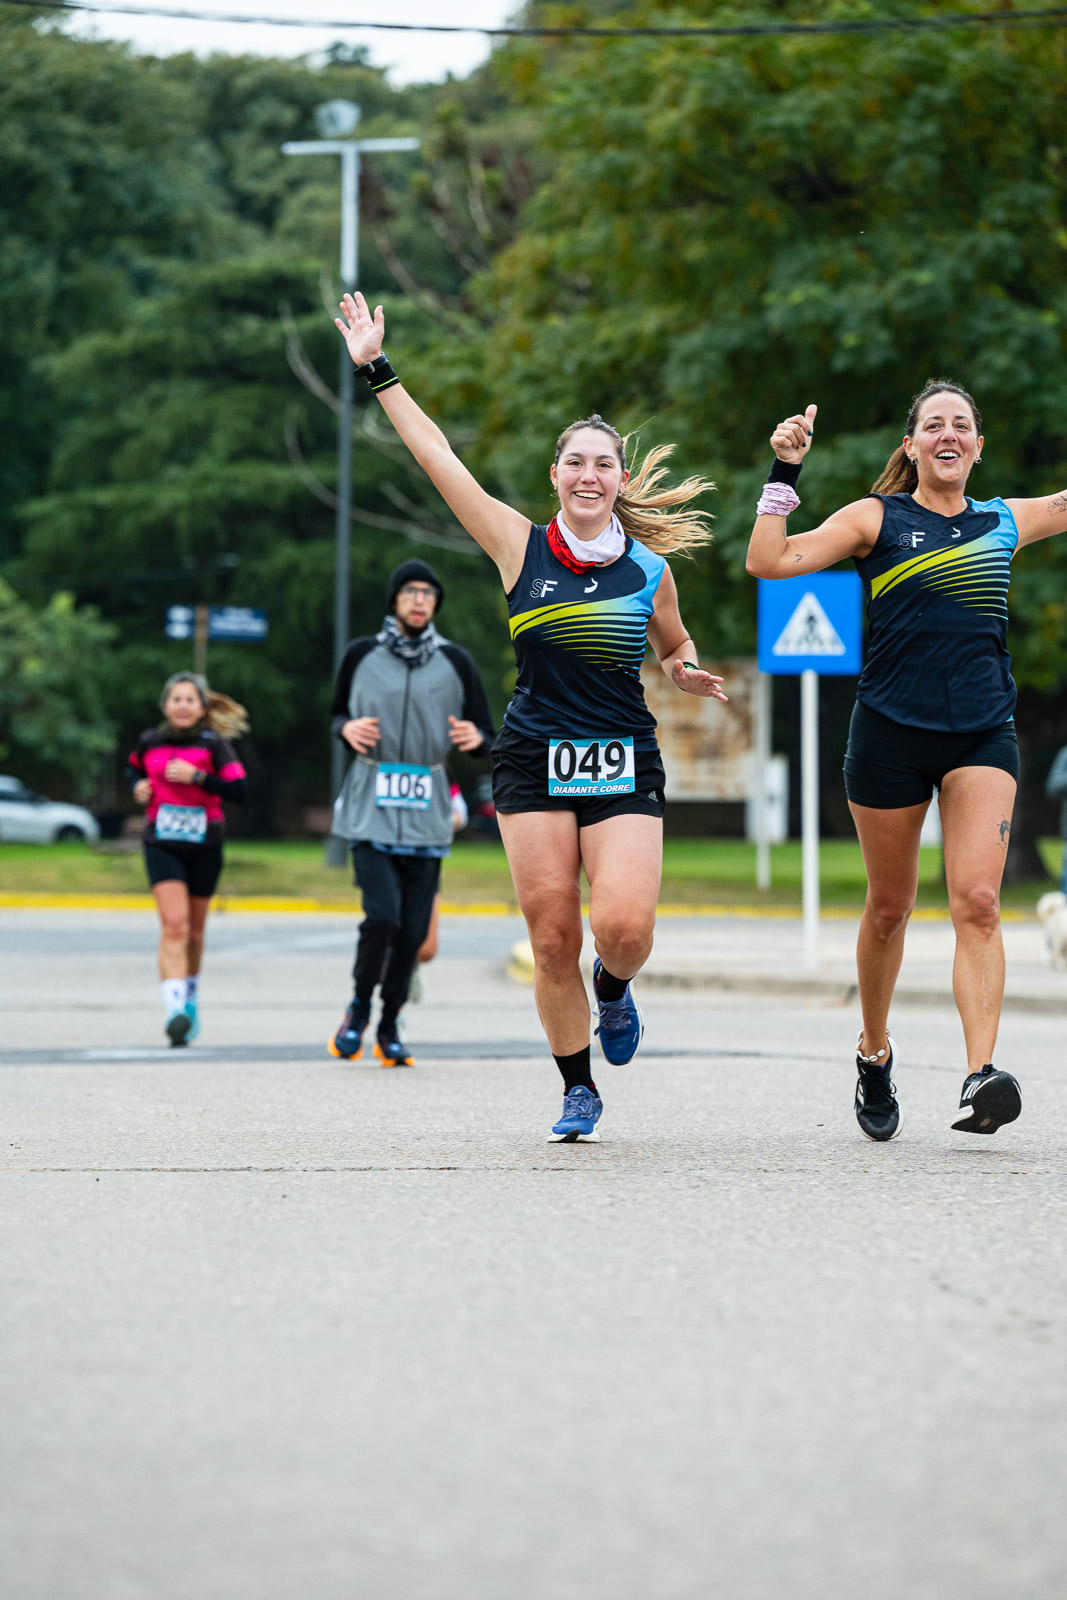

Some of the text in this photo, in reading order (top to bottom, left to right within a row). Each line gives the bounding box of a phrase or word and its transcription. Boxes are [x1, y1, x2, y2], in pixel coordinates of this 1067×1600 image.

[899, 531, 926, 550] SF
[529, 578, 559, 599] SF
[554, 740, 626, 783] 049
[384, 772, 426, 799] 106
[553, 784, 630, 794] DIAMANTE CORRE
